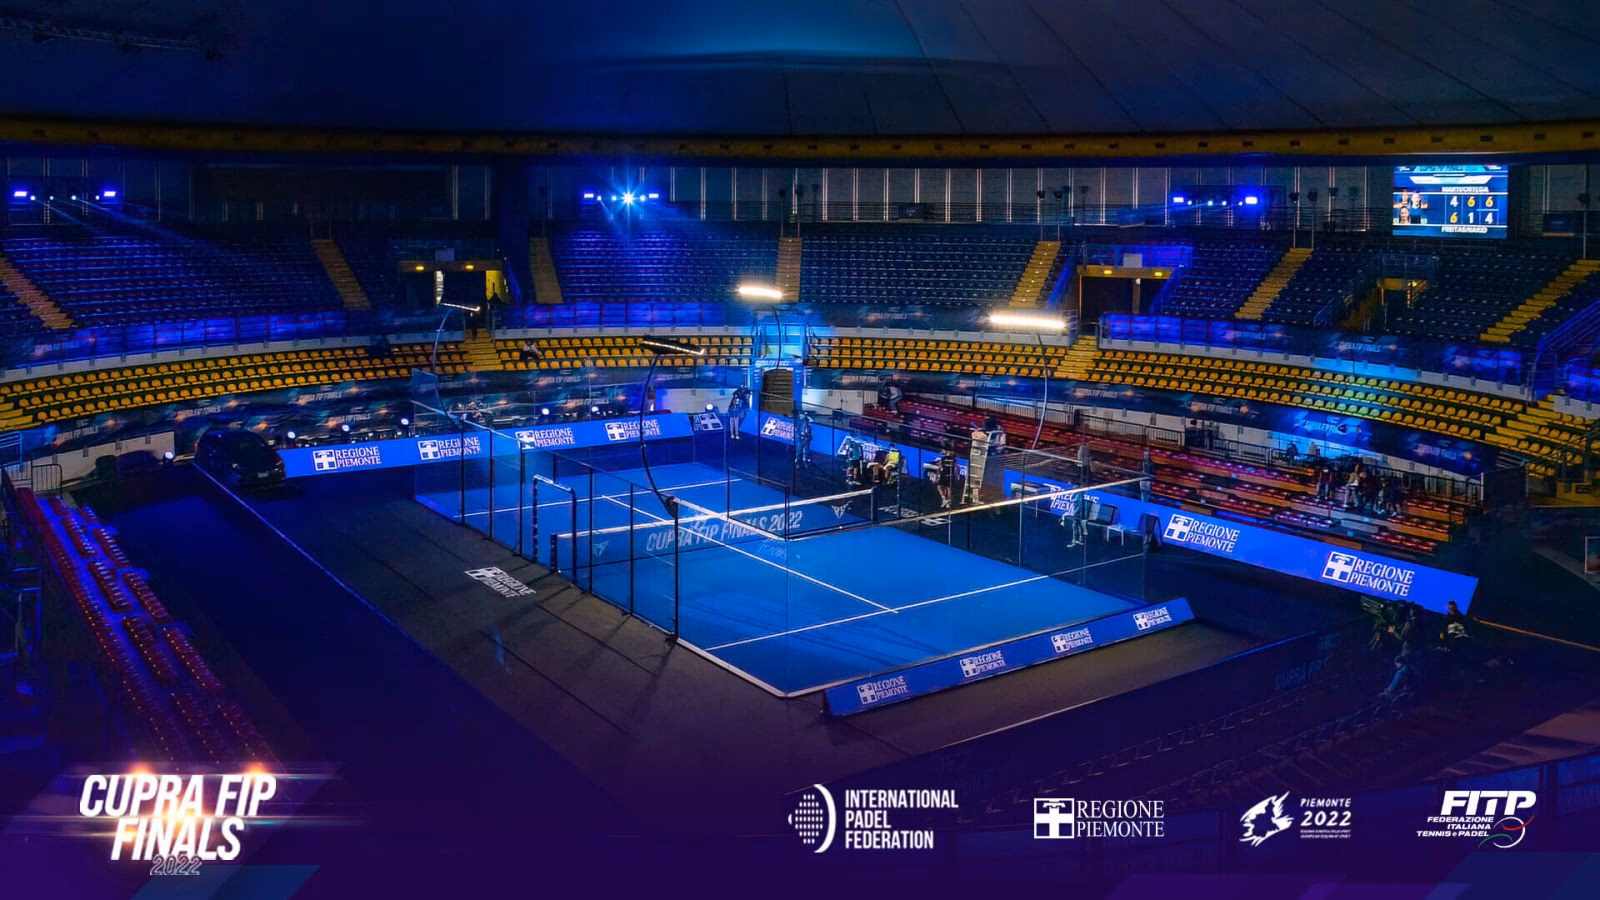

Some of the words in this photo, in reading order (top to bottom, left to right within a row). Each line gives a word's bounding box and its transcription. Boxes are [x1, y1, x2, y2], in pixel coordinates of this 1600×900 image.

[1449, 195, 1459, 208] 4
[1467, 195, 1476, 208] 6
[1485, 195, 1494, 208] 6
[1449, 212, 1459, 224] 6
[1467, 212, 1475, 224] 1
[1484, 212, 1494, 224] 4
[535, 428, 573, 440] REGIONE
[537, 436, 576, 448] PIEMONTE
[336, 446, 379, 459] REGIONE
[337, 456, 382, 468] PIEMONTE
[1191, 520, 1240, 542] REGIONE
[1186, 532, 1235, 553] PIEMONTE
[1353, 559, 1415, 585] REGIONE
[1349, 572, 1410, 597] PIEMONTE
[873, 675, 906, 691] REGIONE
[875, 685, 908, 699] PIEMONTE
